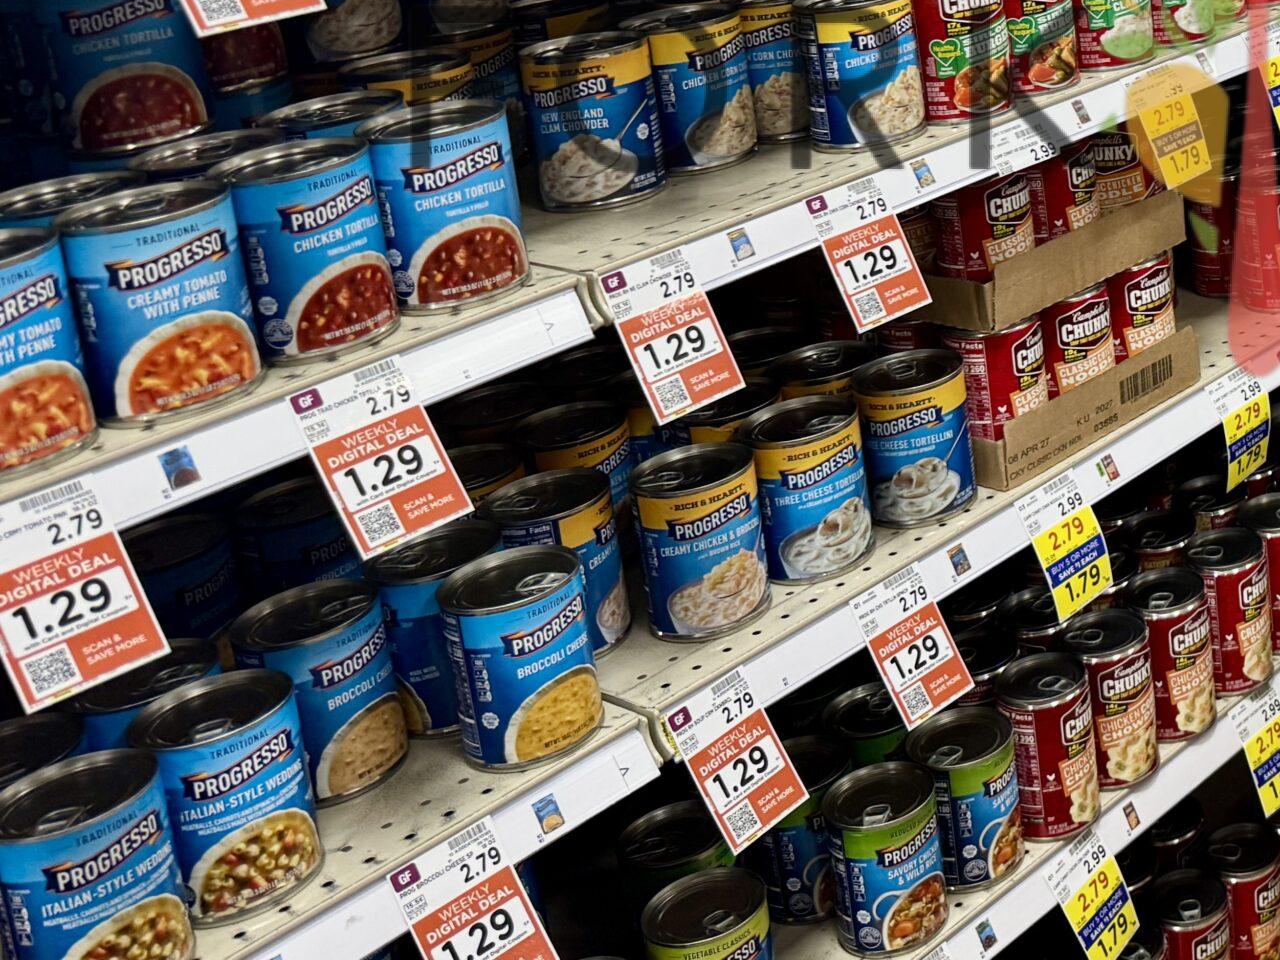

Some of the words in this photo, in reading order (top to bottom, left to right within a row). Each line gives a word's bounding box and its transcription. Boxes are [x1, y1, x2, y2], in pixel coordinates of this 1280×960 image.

[856, 198, 888, 222] 2.79
[136, 222, 200, 247] TRADITIONAL
[118, 232, 222, 290] PROGRESSO
[844, 244, 898, 285] 1.29
[127, 285, 182, 308] CREAMY
[185, 271, 227, 295] TOMATO
[143, 302, 174, 319] WITH
[178, 287, 221, 312] PENNE
[660, 272, 695, 298] 2.79
[643, 325, 707, 371] 1.29
[365, 385, 411, 417] 2.79
[327, 436, 385, 469] DIGITAL
[385, 424, 424, 445] DEAL
[341, 420, 398, 448] WEEKLY
[343, 444, 424, 495] 1.29
[402, 498, 427, 512] SCAN
[407, 504, 432, 521] SAVE
[430, 494, 455, 509] MORE
[1058, 493, 1083, 515] 2.99
[47, 509, 104, 545] 2.79
[1047, 516, 1086, 550] 2.79
[899, 586, 928, 612] 2.79
[1064, 565, 1101, 604] 1.79
[12, 577, 111, 640] 1.29
[512, 598, 583, 656] PROGRESSO
[516, 648, 565, 679] BROCCOLI
[890, 636, 940, 680] 1.29
[721, 693, 755, 724] 2.79
[193, 735, 288, 799] PROGRESSO
[712, 746, 769, 799] 1.29
[181, 777, 266, 822] ITALIAN-STYLE
[264, 759, 304, 794] WEDDING
